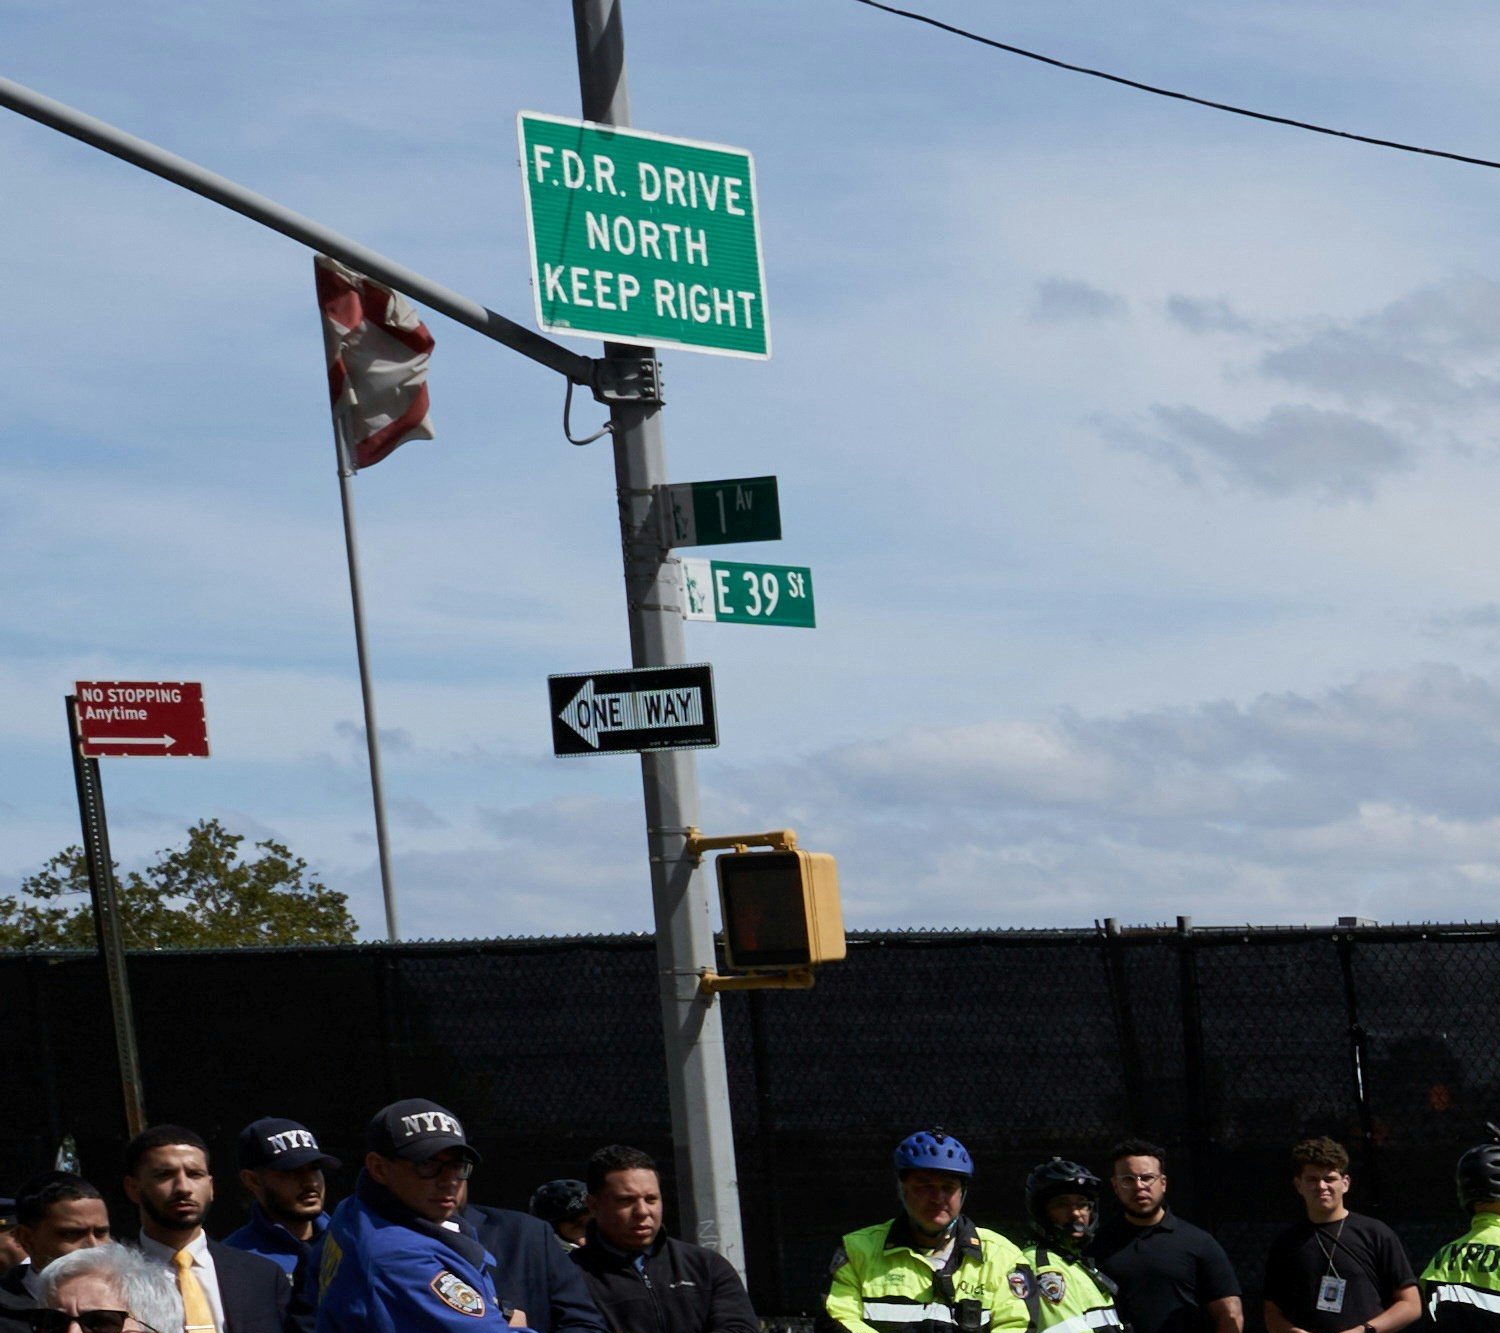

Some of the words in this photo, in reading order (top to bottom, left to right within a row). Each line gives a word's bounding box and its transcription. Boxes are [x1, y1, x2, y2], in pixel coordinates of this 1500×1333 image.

[533, 144, 626, 197] F.D.R.
[638, 161, 745, 217] DRIVE
[585, 210, 708, 267] NORTH
[544, 262, 640, 312] KEEP
[654, 278, 755, 330] RIGHT
[716, 491, 727, 534] 1
[736, 485, 753, 511] Av
[715, 569, 734, 615] E
[743, 570, 780, 617] 39
[786, 570, 806, 600] St
[82, 688, 103, 702] NO
[107, 688, 181, 703] STOPPING
[85, 705, 148, 723] Anytime
[577, 698, 623, 730] ONE
[643, 690, 692, 726] WAY
